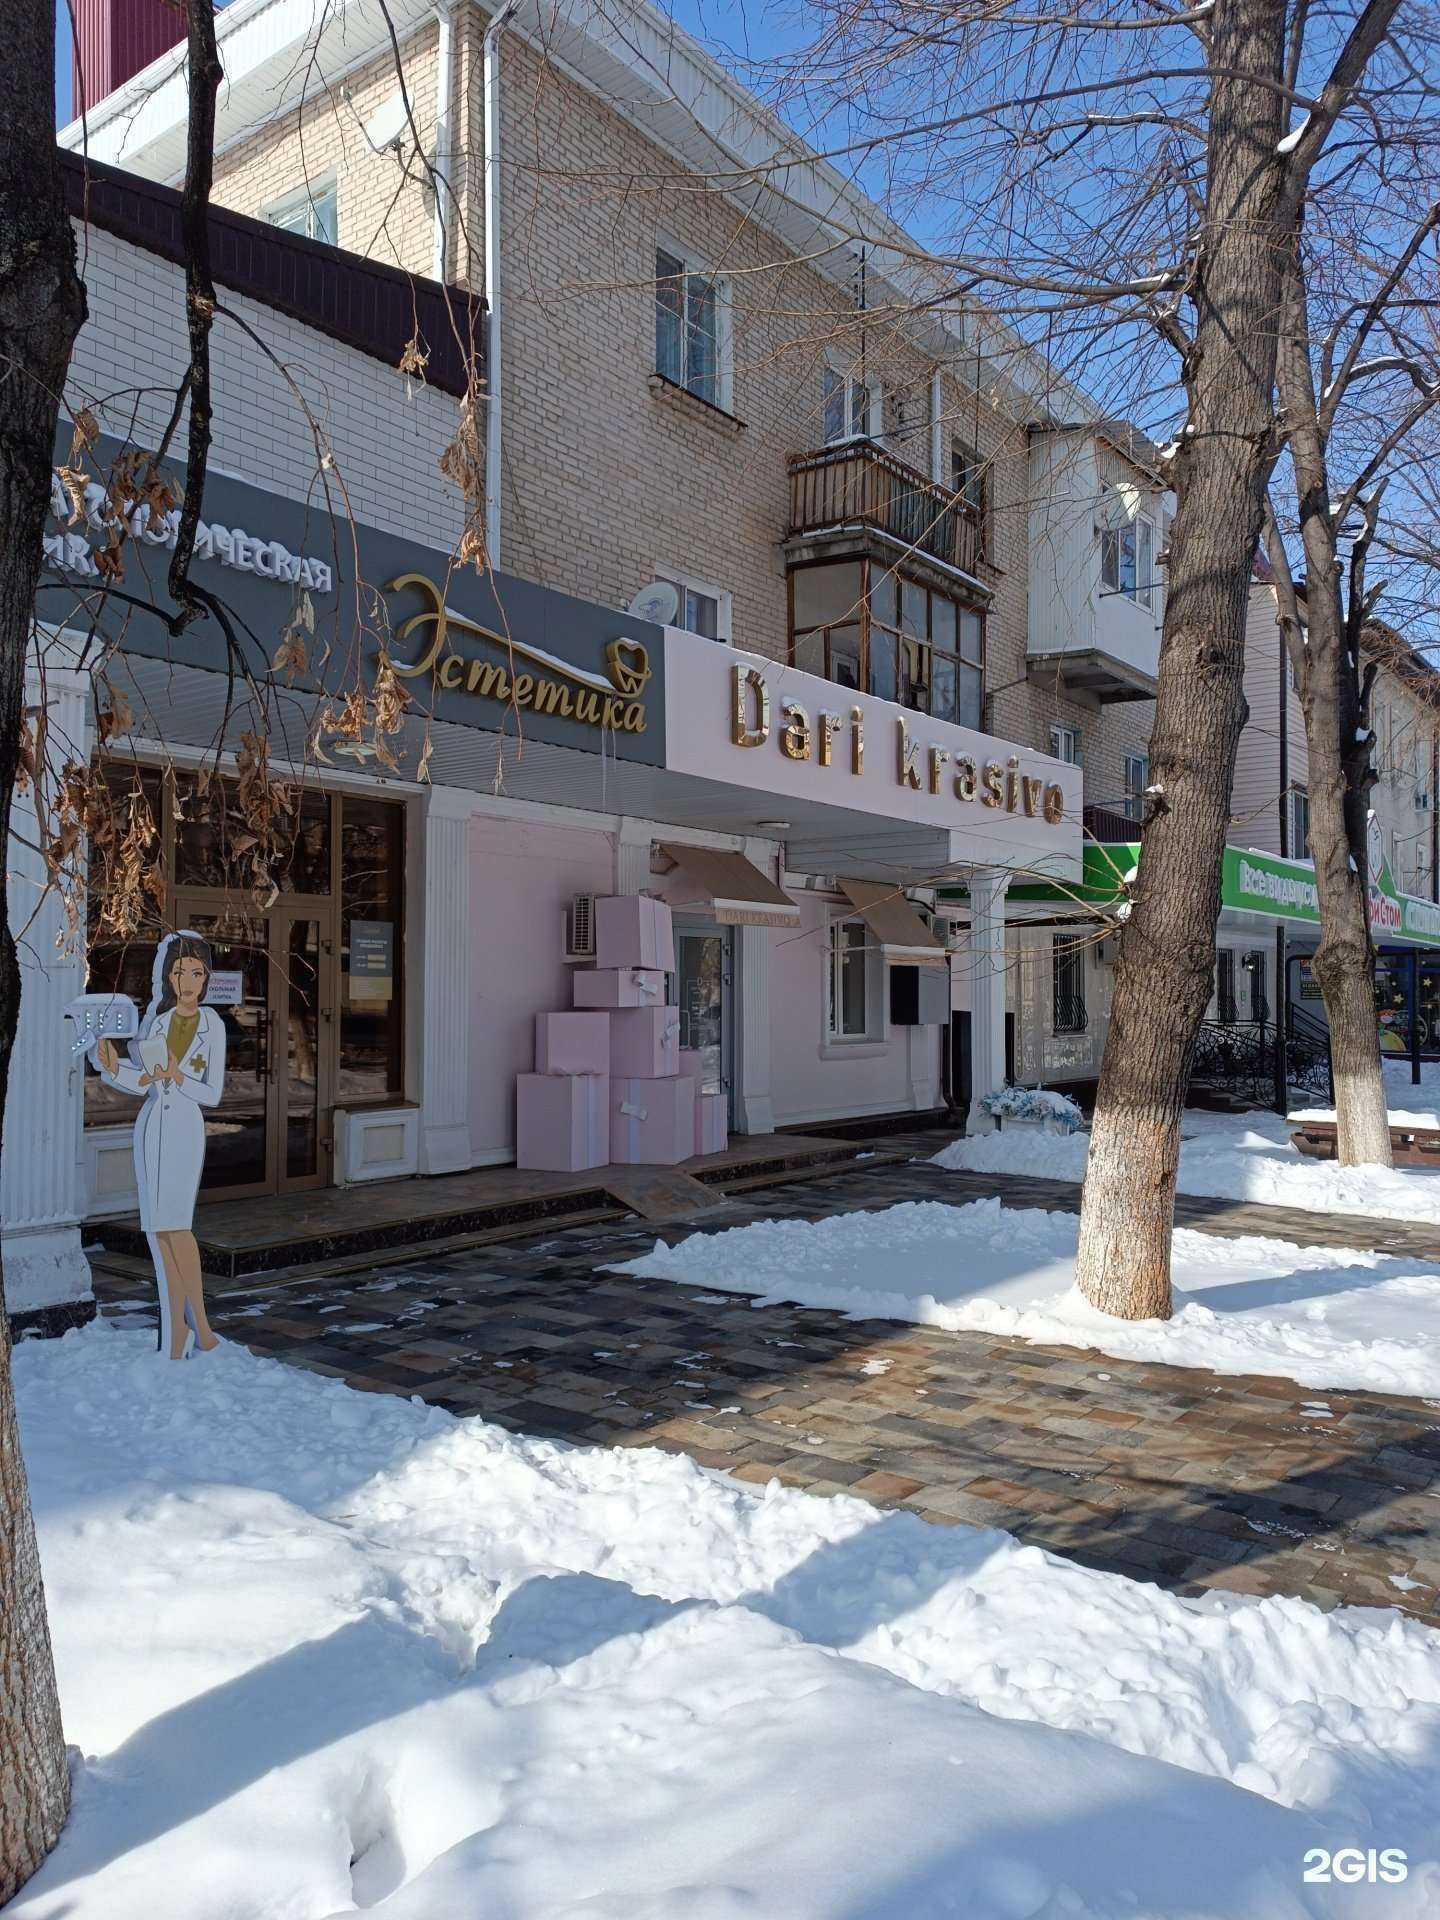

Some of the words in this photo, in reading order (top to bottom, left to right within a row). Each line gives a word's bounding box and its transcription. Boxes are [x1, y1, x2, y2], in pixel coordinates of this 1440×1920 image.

[383, 573, 648, 733] Эстетика
[731, 661, 865, 776] Dari
[896, 715, 1064, 825] krasivo
